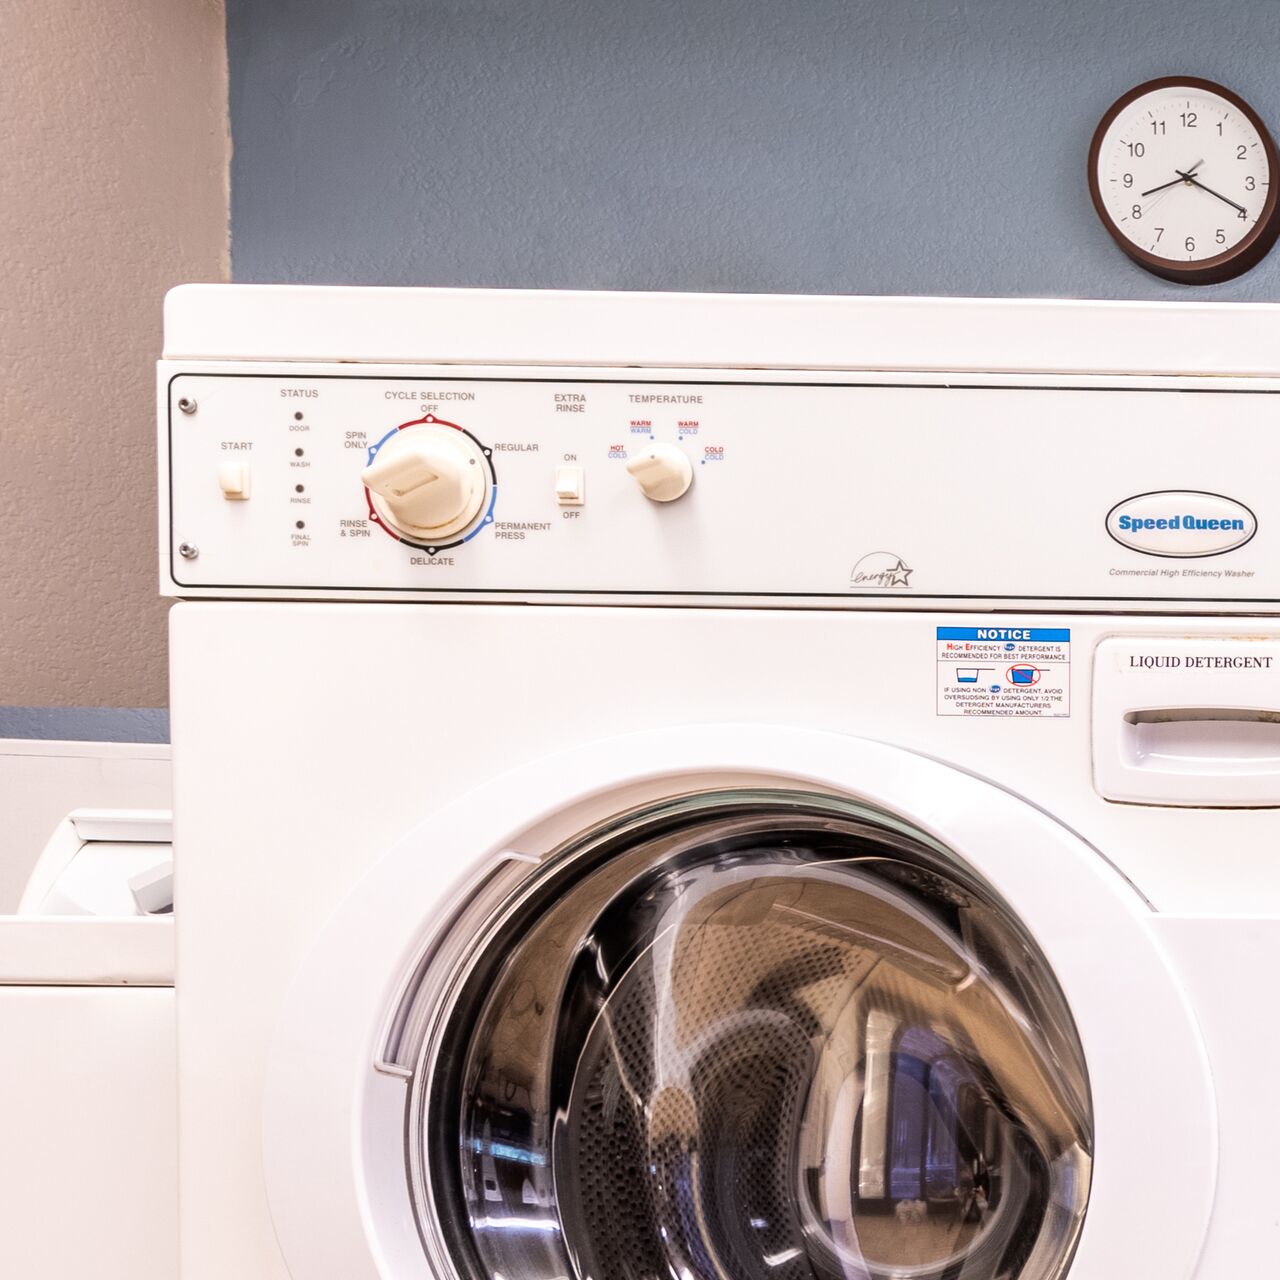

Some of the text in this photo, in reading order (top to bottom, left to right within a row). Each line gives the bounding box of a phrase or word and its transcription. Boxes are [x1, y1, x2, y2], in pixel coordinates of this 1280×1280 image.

[1180, 113, 1197, 127] 12
[1151, 121, 1165, 135] 11
[1216, 122, 1222, 136] 1
[1127, 143, 1145, 157] 10
[1237, 145, 1247, 160] 2
[1123, 173, 1133, 188] 9
[1245, 176, 1255, 191] 3
[1132, 205, 1142, 219] 8
[1237, 208, 1247, 221] 4
[1154, 228, 1164, 242] 7
[1216, 229, 1225, 244] 5
[1185, 237, 1195, 251] 6
[280, 389, 319, 398] STATUS
[385, 391, 475, 400] CYCLE SELECTION
[554, 394, 586, 402] EXTRA
[629, 395, 703, 404] TEMPERATURE
[421, 404, 438, 412] OFF
[556, 404, 584, 412] RINSE
[221, 442, 253, 450] START
[494, 443, 538, 451] REGULAR
[340, 520, 367, 528] RINSE
[495, 522, 551, 530] PERMANENT
[1119, 515, 1244, 532] Speed Queen
[340, 529, 370, 537] & SPIN
[410, 557, 454, 565] DELICATE
[1109, 568, 1158, 576] Commercial
[1160, 569, 1179, 578] High
[1182, 569, 1222, 578] Efficiency
[978, 629, 1030, 640] NOTICE
[1130, 656, 1272, 669] LIQUID DETERGENT
